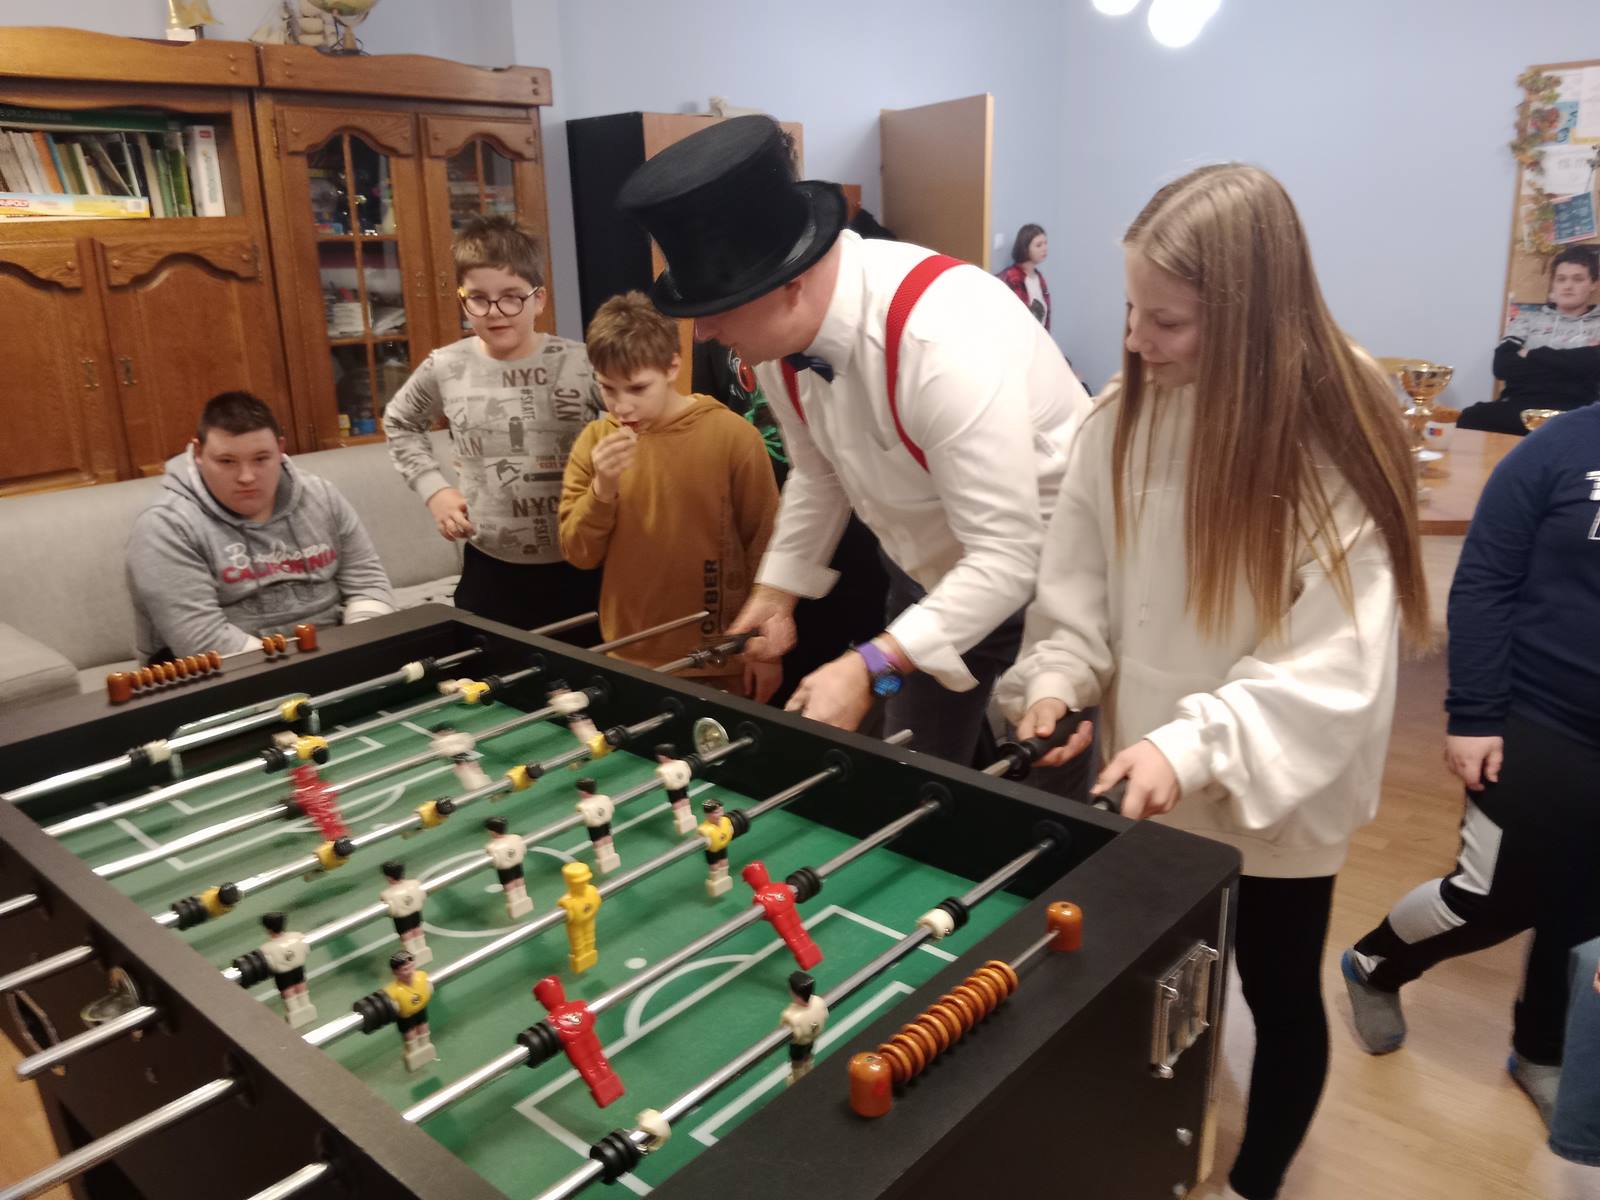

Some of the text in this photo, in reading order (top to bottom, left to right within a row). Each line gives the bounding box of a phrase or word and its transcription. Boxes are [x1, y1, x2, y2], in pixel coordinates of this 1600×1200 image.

[502, 367, 548, 388] NYC
[520, 388, 536, 421] #SKATE
[554, 388, 582, 422] NYC
[512, 495, 560, 518] NYC
